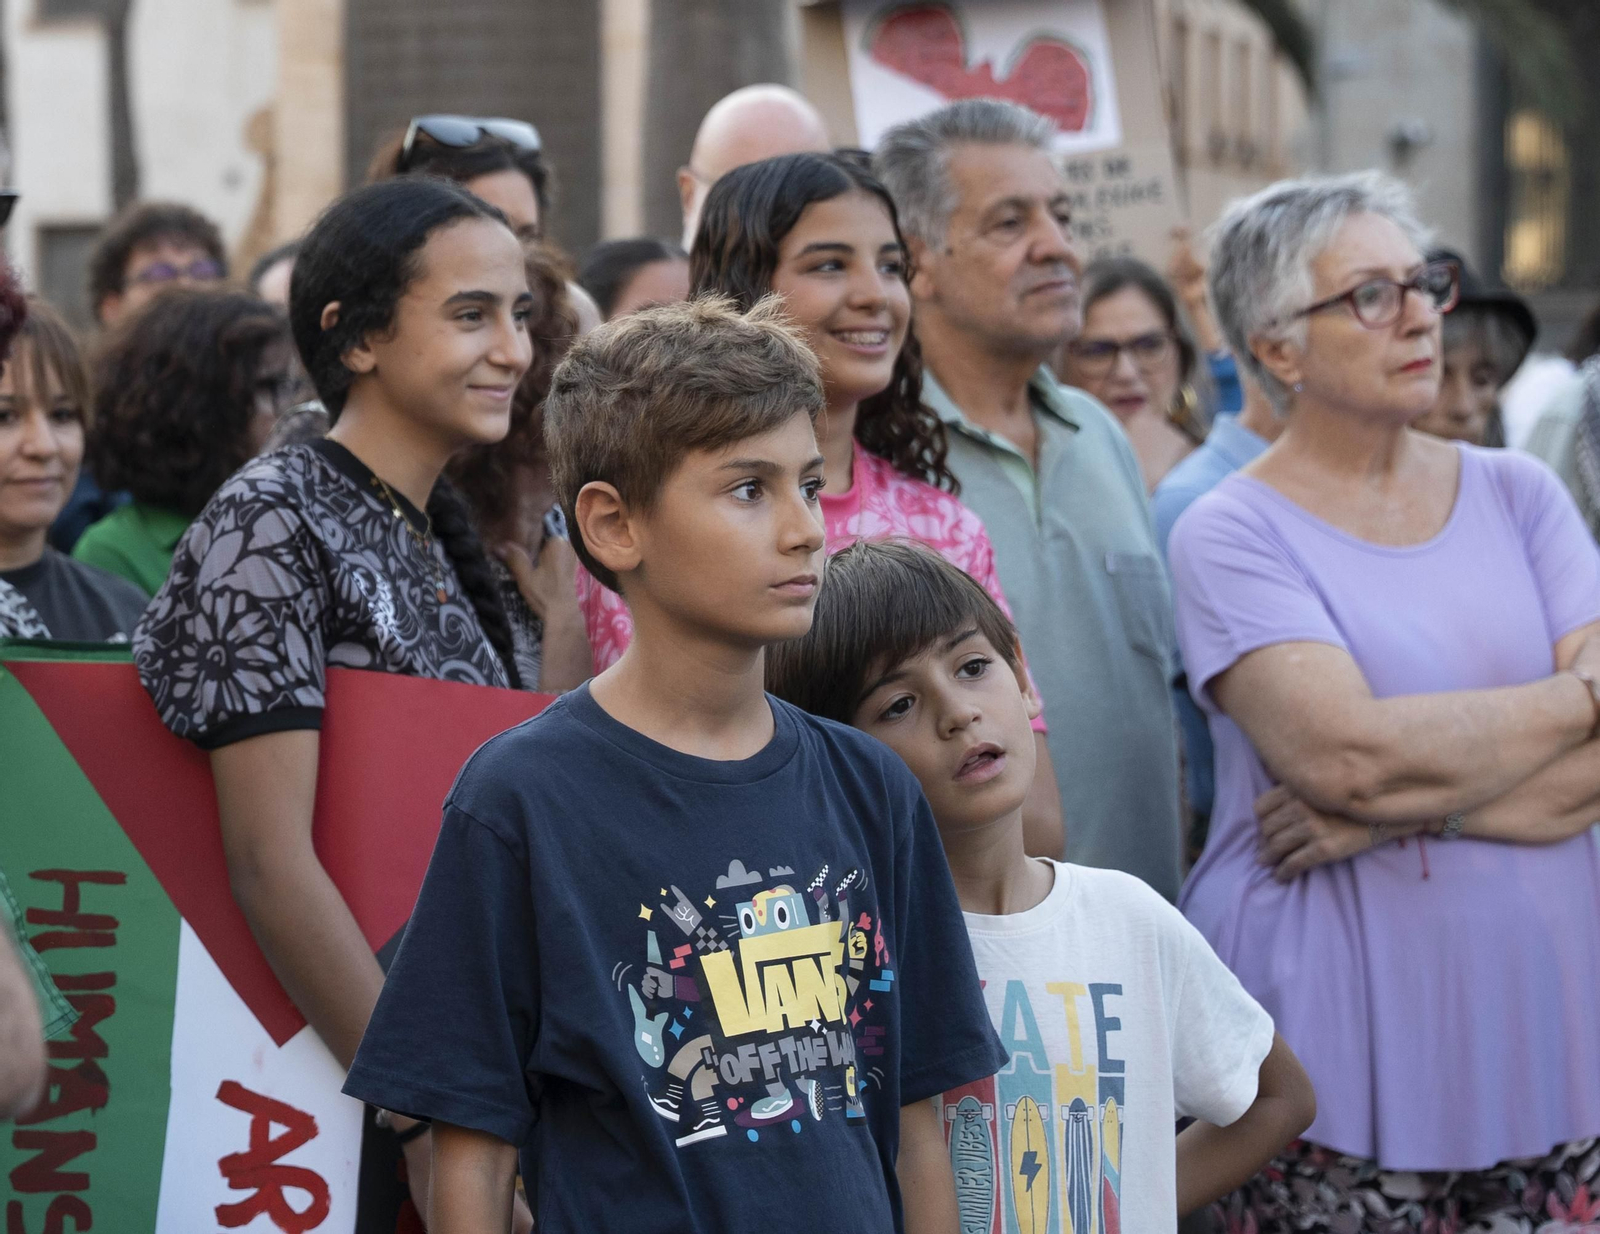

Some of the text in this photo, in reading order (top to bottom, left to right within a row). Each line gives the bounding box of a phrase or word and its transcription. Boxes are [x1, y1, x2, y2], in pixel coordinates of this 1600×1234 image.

[778, 1035, 828, 1074] THE
[979, 979, 1125, 1074] ATE
[214, 1079, 331, 1234] AR
[955, 1121, 993, 1234] SUMMER VIBES
